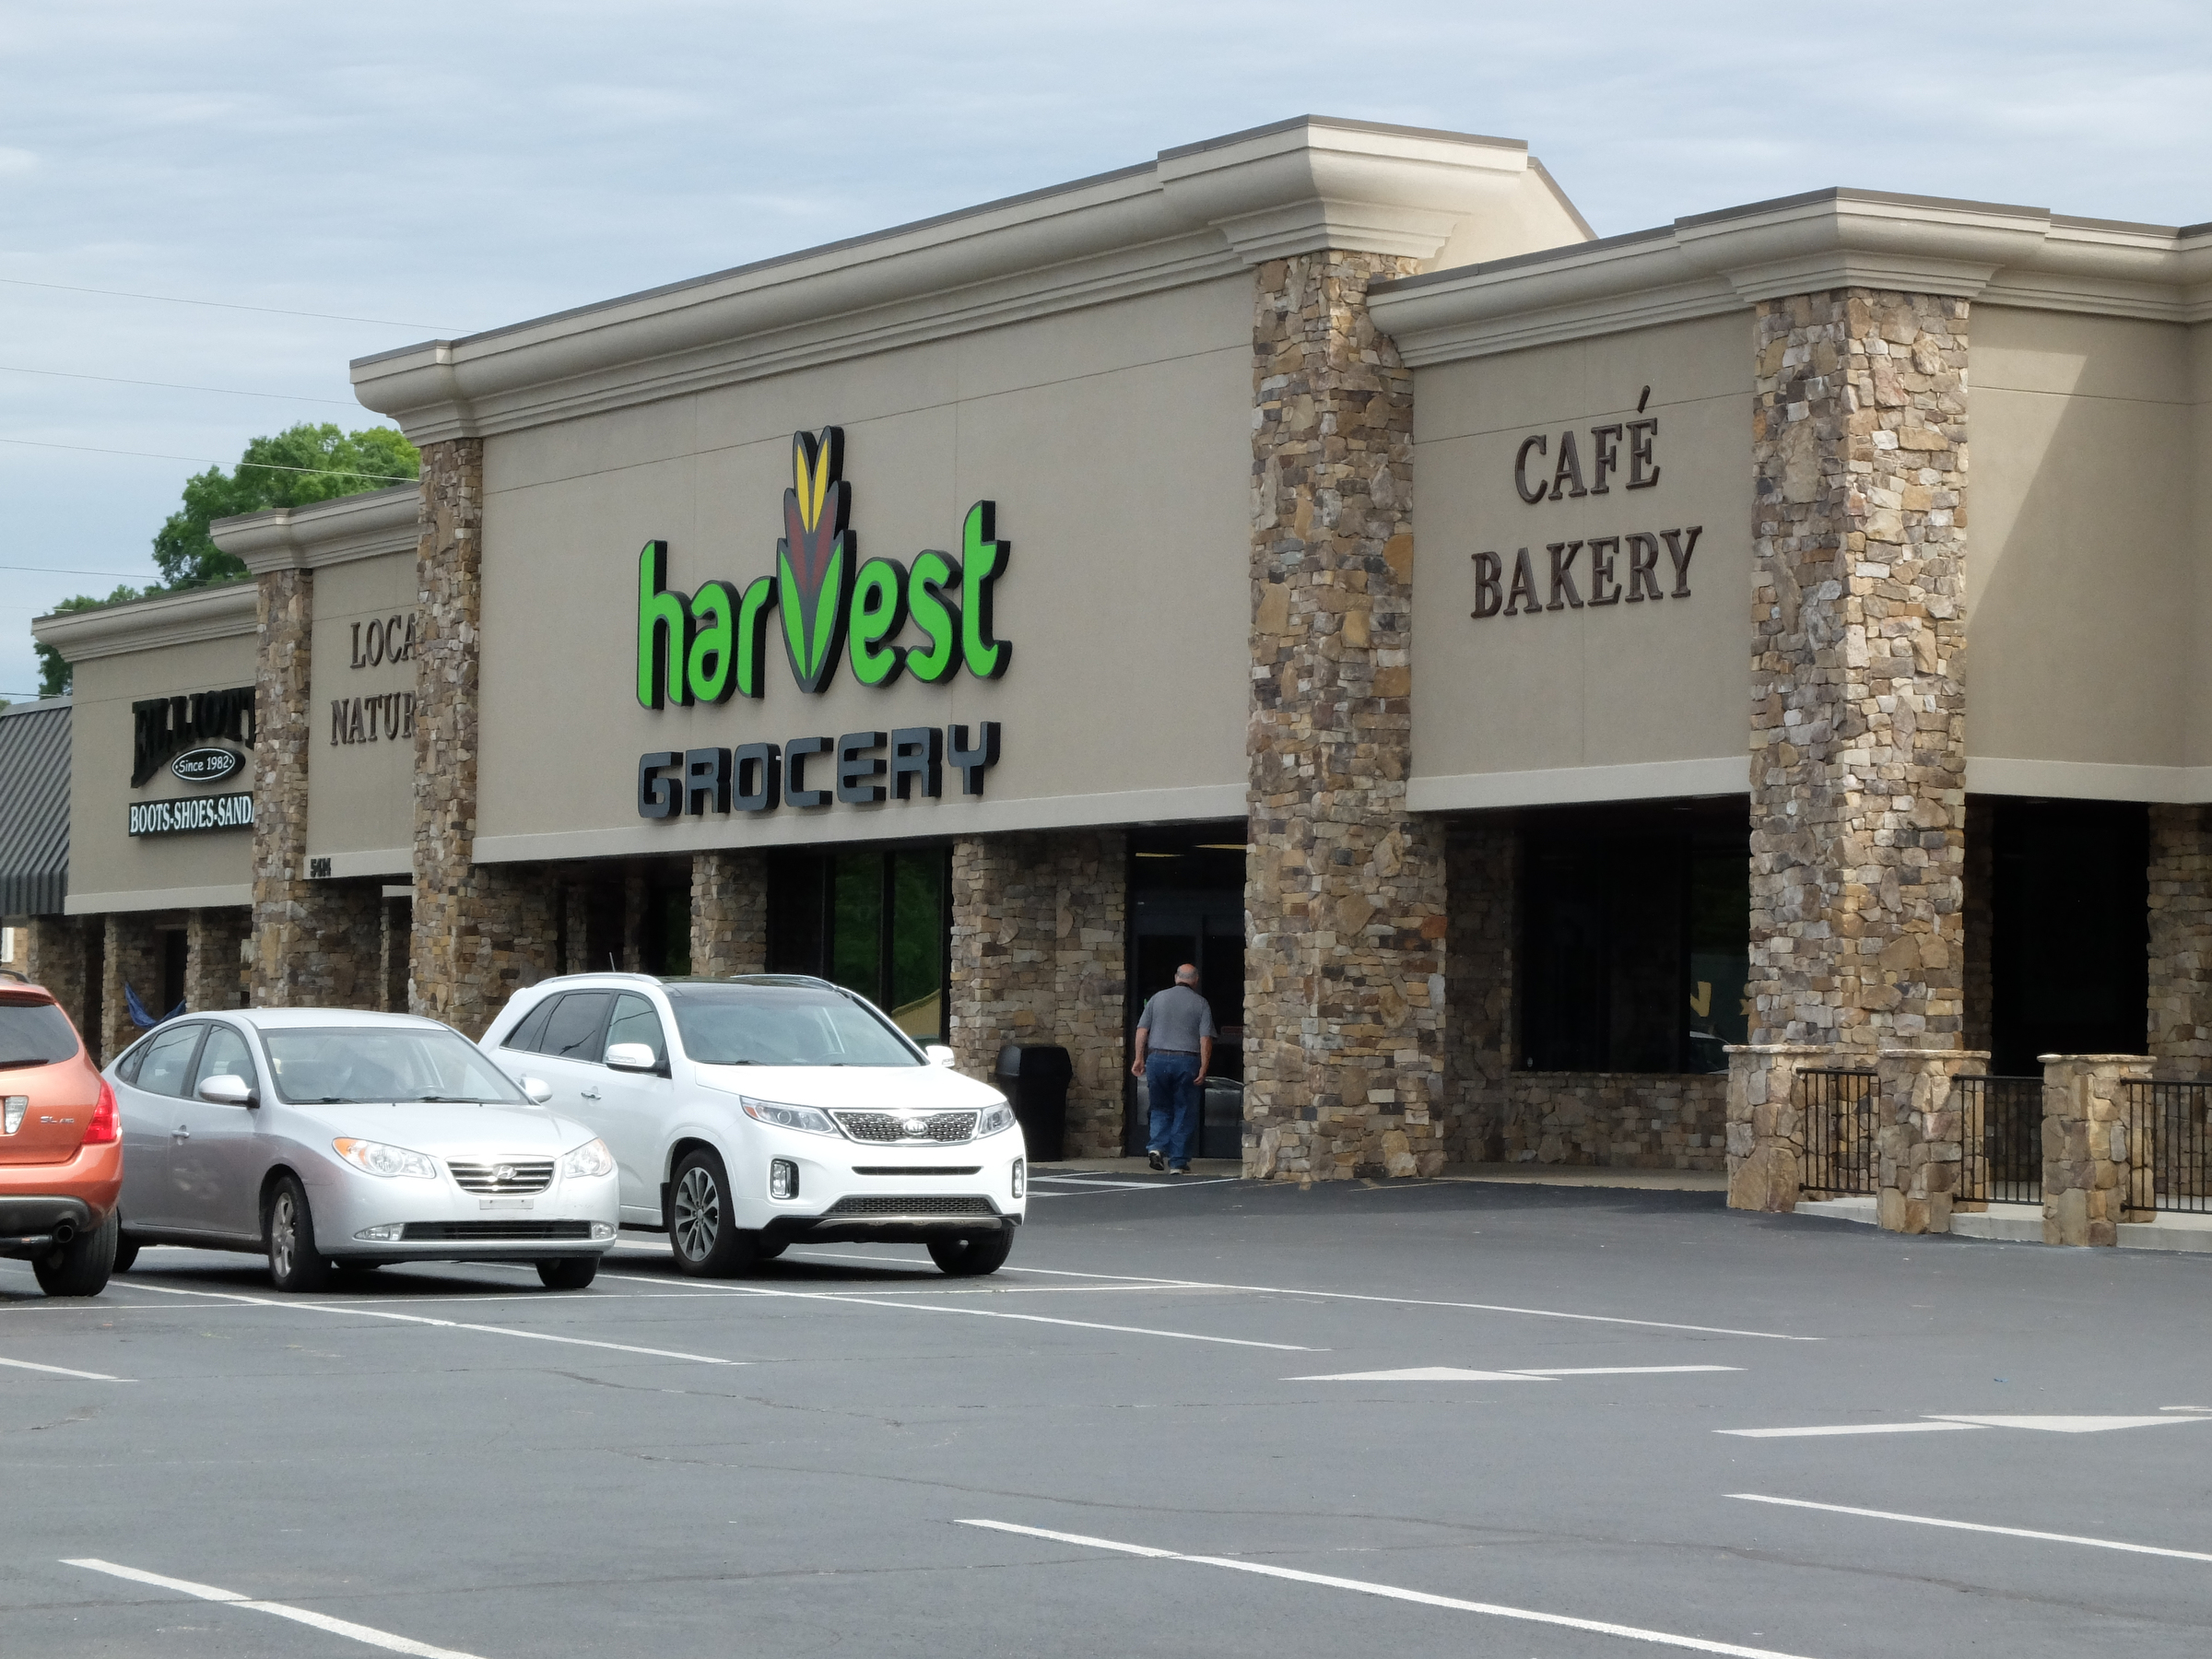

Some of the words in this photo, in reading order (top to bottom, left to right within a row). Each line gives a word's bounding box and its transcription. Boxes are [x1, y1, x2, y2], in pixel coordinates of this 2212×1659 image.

[1514, 385, 1661, 504] CAFÉ
[637, 426, 1012, 710] harvest
[1470, 525, 1703, 619] BAKERY
[179, 758, 204, 773] Since
[206, 755, 229, 771] 1982
[638, 721, 1002, 818] GROCERY
[130, 795, 254, 833] BOOTS-SHOES-SAND
